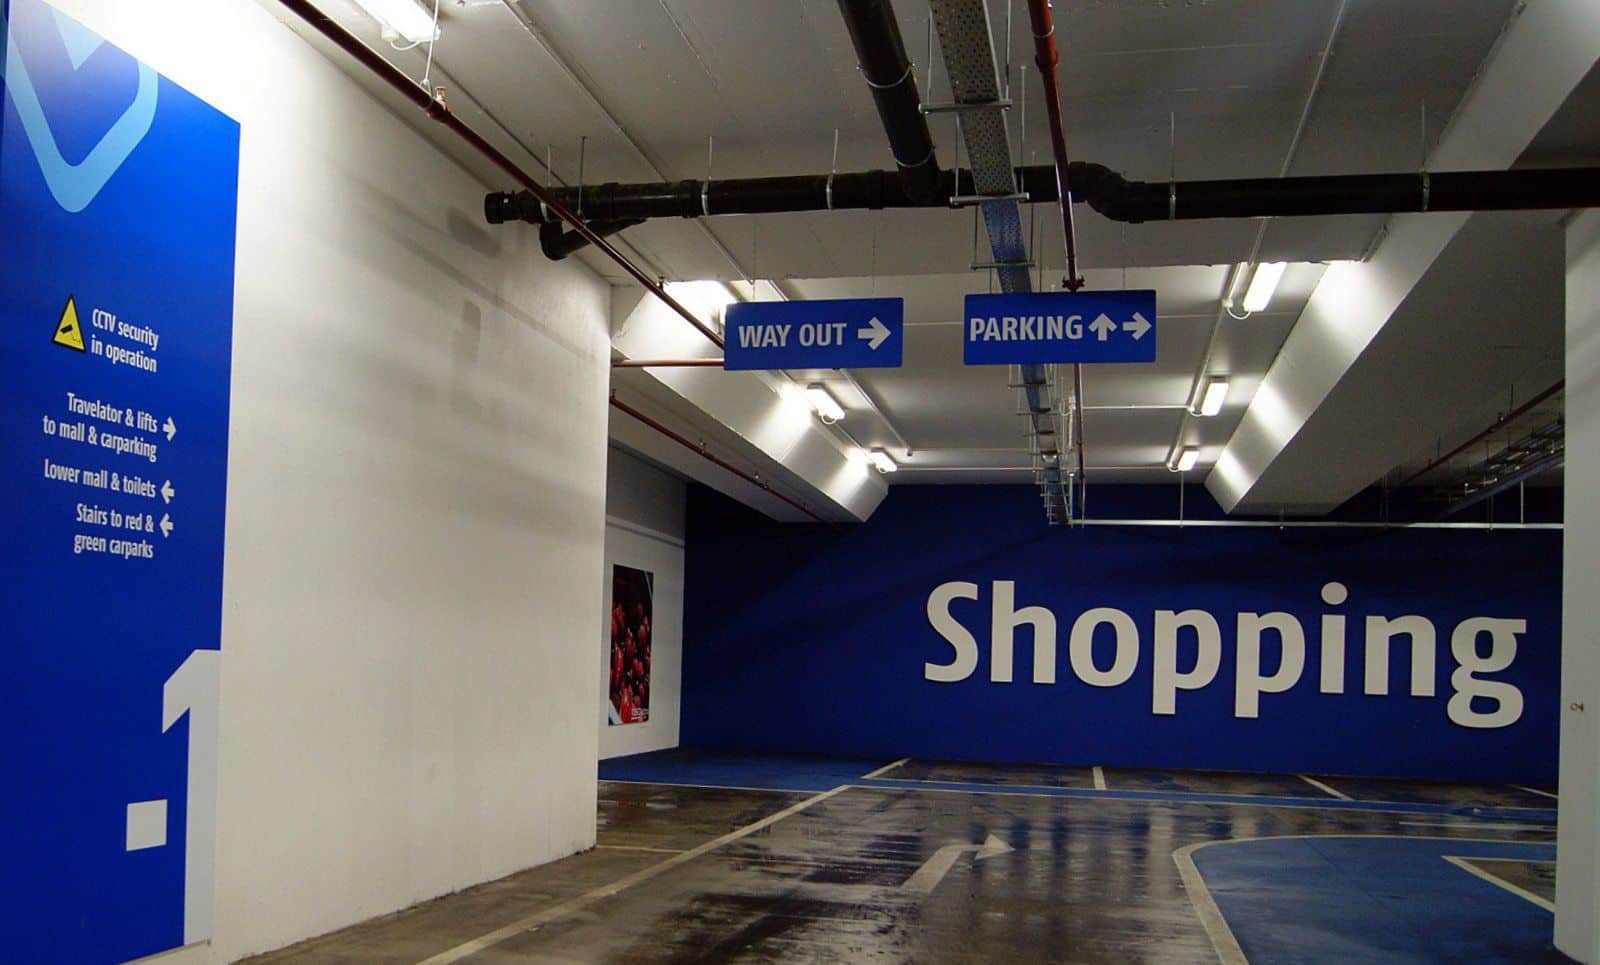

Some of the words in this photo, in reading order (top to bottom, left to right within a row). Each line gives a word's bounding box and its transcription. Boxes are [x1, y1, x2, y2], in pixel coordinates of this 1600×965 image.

[92, 308, 117, 333] CCTV
[117, 320, 159, 352] security
[738, 325, 791, 348] WAY
[799, 323, 847, 347] OUT
[970, 315, 1083, 342] PARKING
[91, 333, 103, 356] in
[105, 343, 157, 373] operation
[67, 391, 123, 424] Travelator
[124, 408, 135, 428] &
[137, 410, 158, 433] lifts
[42, 415, 56, 435] to
[59, 421, 85, 442] mall
[87, 425, 98, 445] &
[100, 432, 157, 463] carparking
[44, 458, 80, 483] Lower
[82, 469, 108, 489] mall
[110, 472, 121, 492] &
[123, 475, 156, 498] toilets
[76, 503, 108, 526] Stairs
[110, 509, 122, 528] to
[124, 513, 143, 531] red
[144, 514, 155, 533] &
[74, 534, 107, 554] green
[109, 539, 154, 560] carparks
[924, 579, 1527, 730] Shopping
